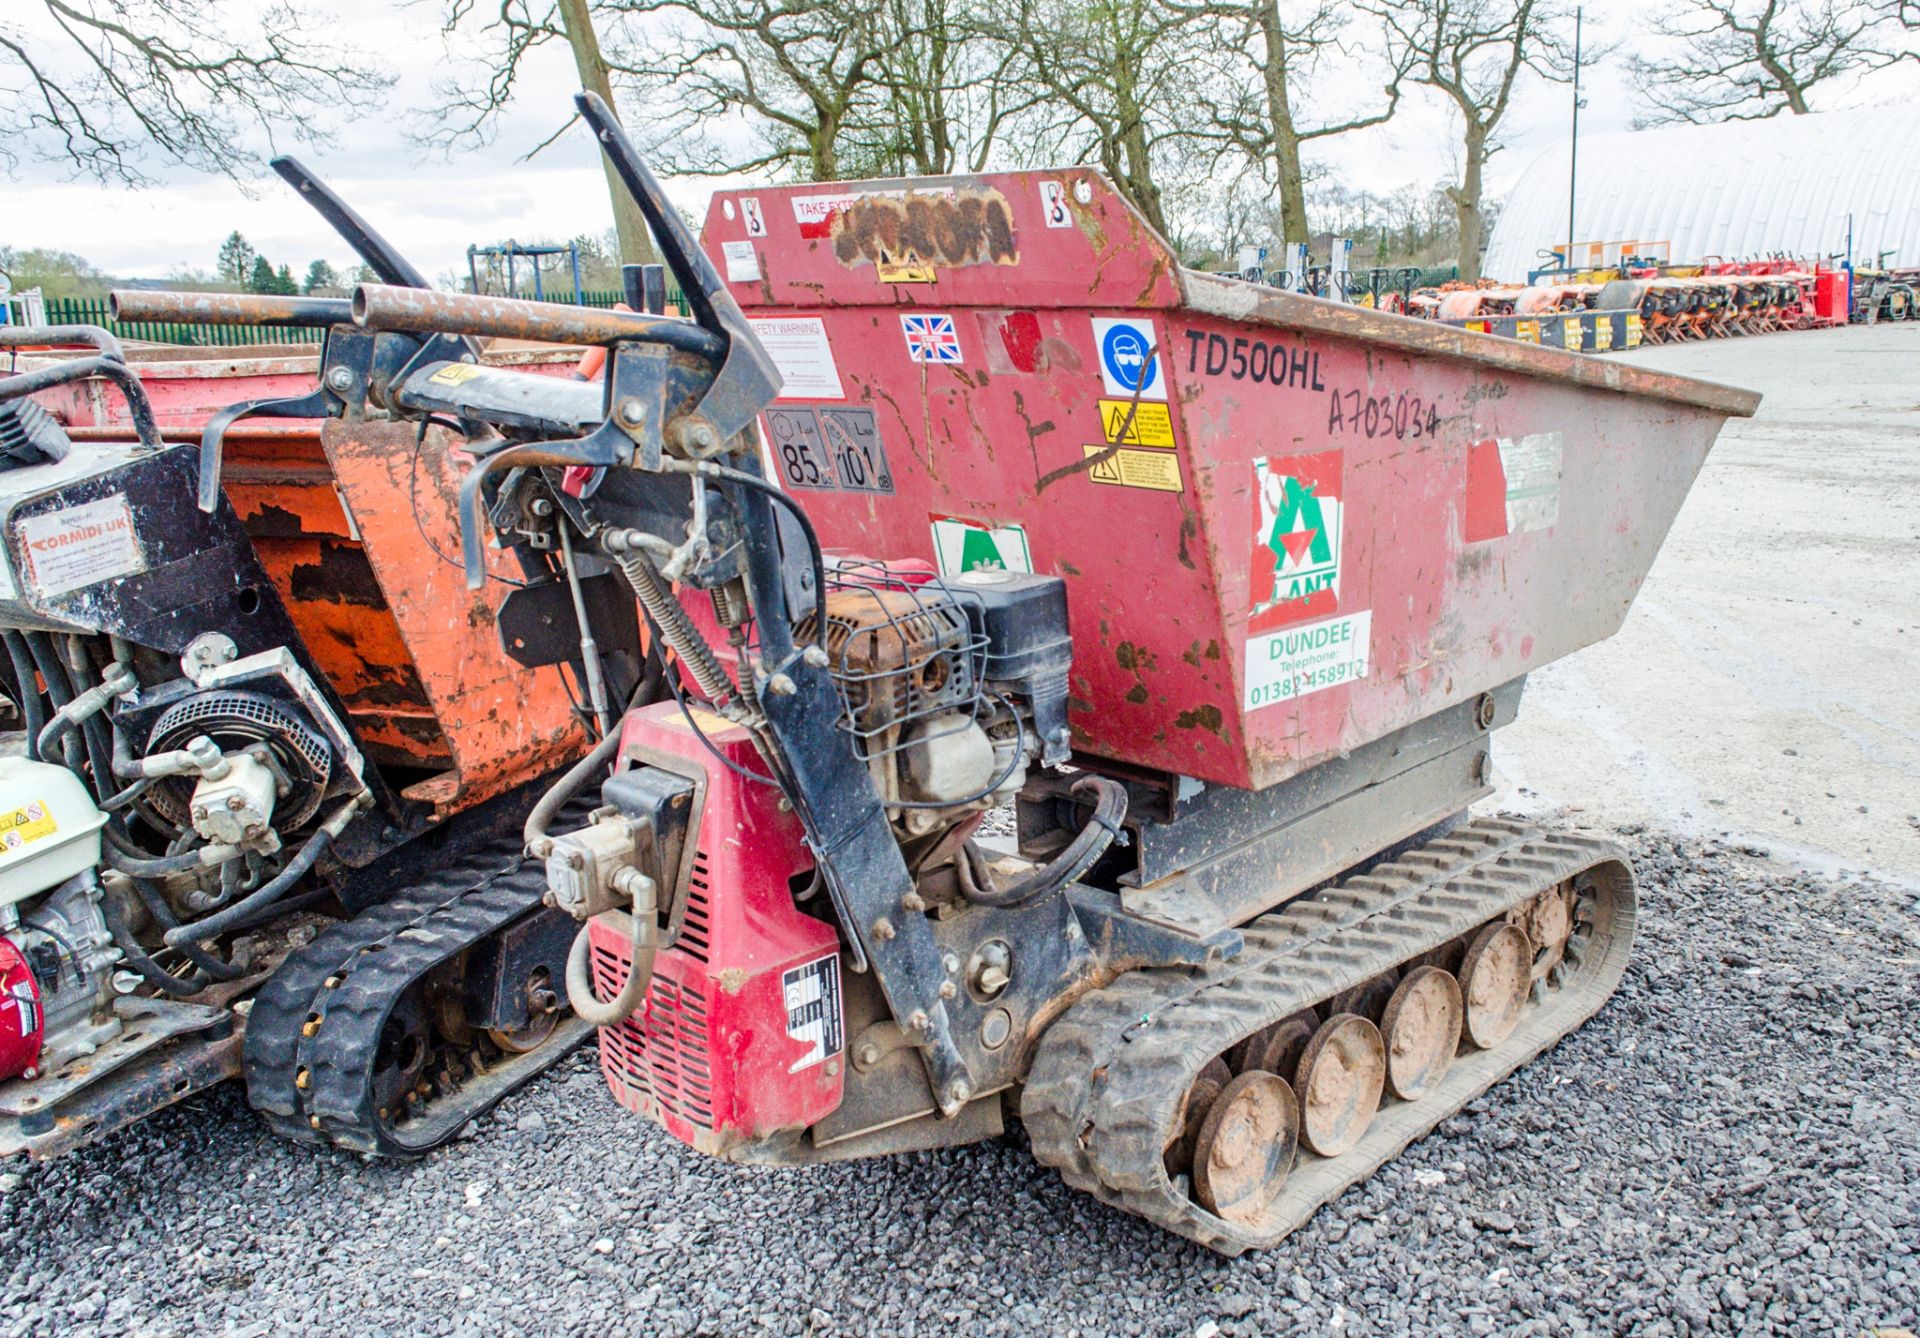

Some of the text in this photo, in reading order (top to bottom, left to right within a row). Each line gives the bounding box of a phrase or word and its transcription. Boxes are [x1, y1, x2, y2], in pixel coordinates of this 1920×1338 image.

[798, 201, 824, 216] TAKE
[752, 322, 820, 335] AFETY WARNING
[1186, 329, 1325, 392] TD500HL
[783, 443, 820, 484] 85
[836, 445, 875, 486] 101
[106, 518, 127, 532] UK
[1269, 620, 1352, 660] DUNDEE
